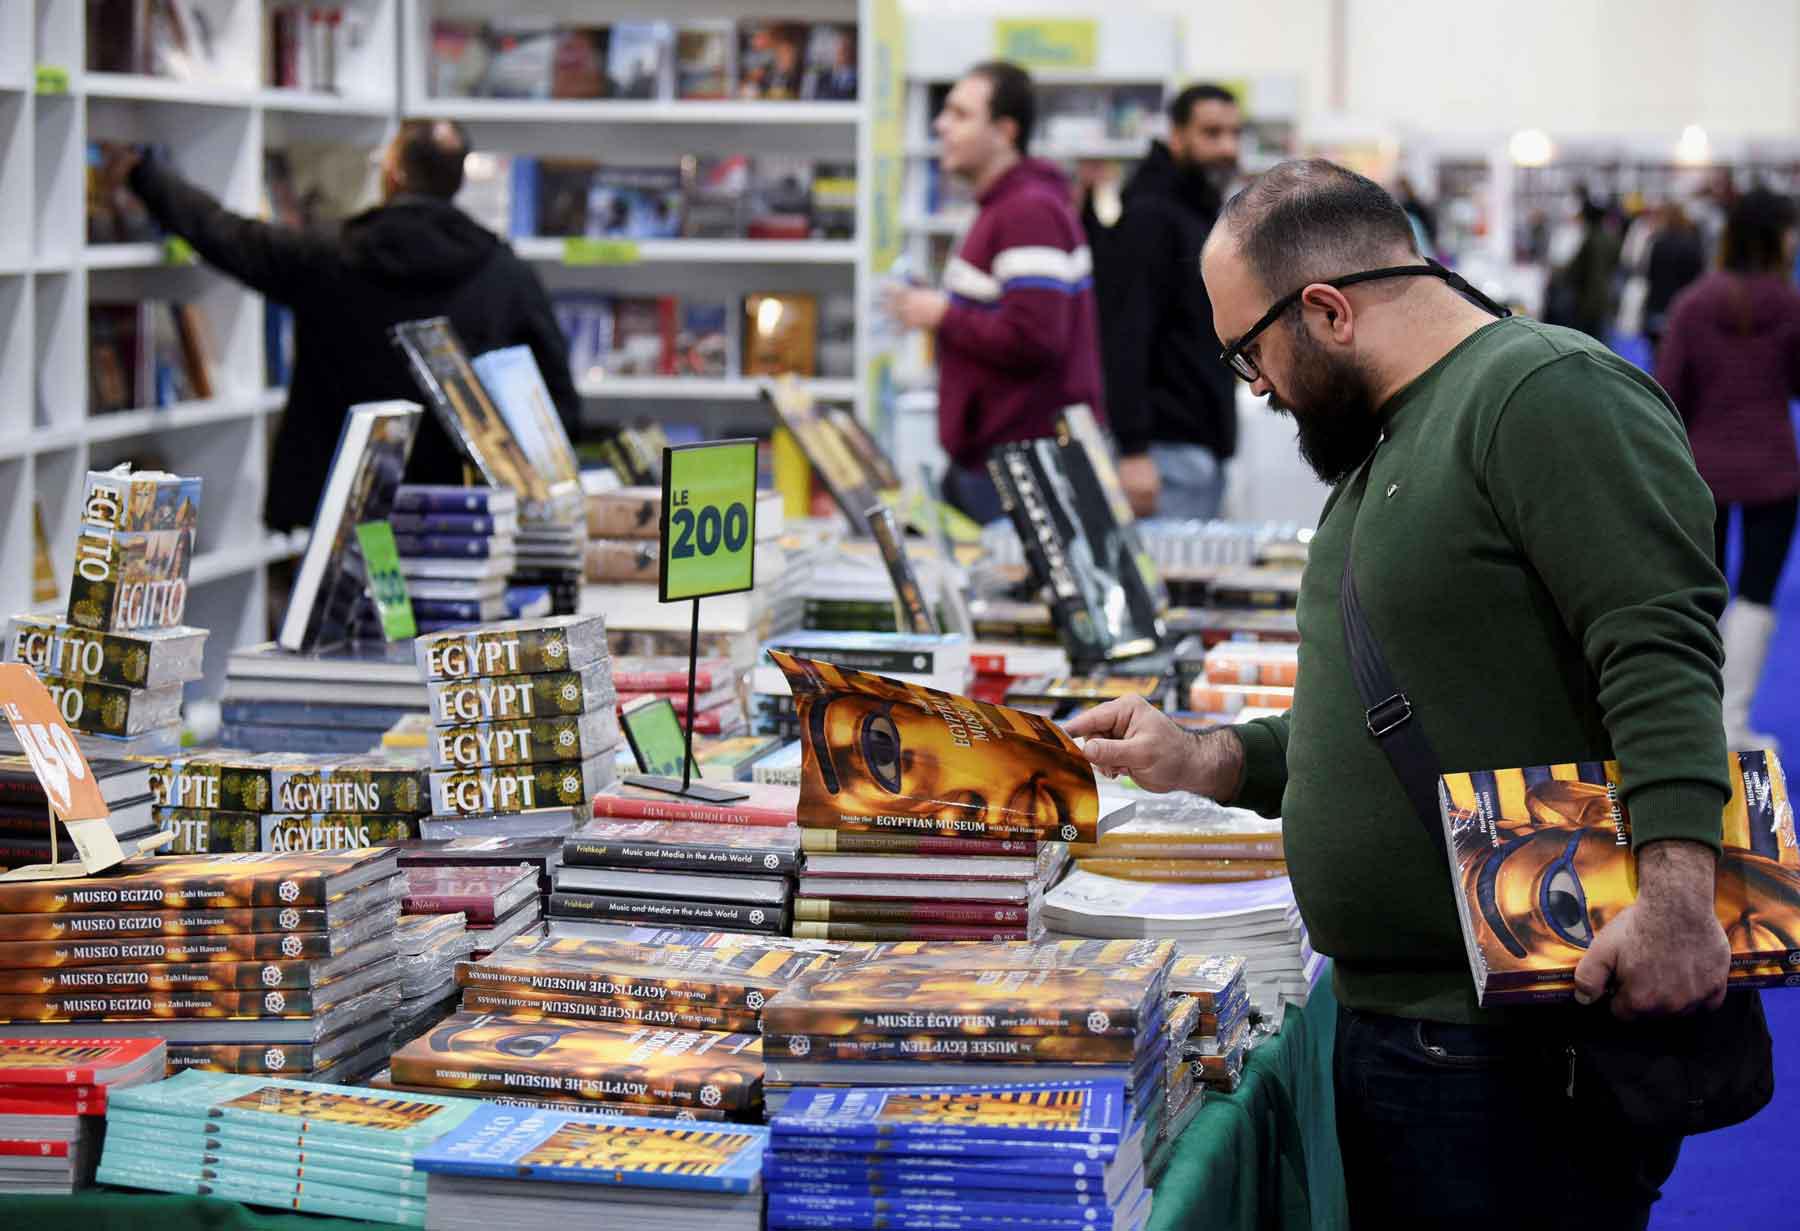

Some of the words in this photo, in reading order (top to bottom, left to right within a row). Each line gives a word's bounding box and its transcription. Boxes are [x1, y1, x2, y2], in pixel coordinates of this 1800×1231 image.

[672, 490, 689, 506] LE
[79, 485, 121, 581] EGITTO
[671, 502, 749, 559] 200
[115, 577, 188, 629] EGITTO
[14, 631, 105, 676] EGITTO
[426, 640, 520, 678] EGYPT
[438, 683, 534, 721] EGYPT
[437, 728, 532, 767] EGYPT
[14, 722, 86, 817] 150
[439, 775, 535, 812] EGYPT
[1606, 781, 1618, 802] the
[877, 815, 933, 829] EGYPTIAN
[936, 819, 985, 832] MUSEUM
[1609, 804, 1628, 846] Inside
[576, 845, 608, 855] Frishkopf
[622, 848, 643, 857] Music
[645, 849, 660, 858] and
[661, 850, 685, 859] Media
[687, 851, 694, 860] in
[695, 851, 707, 860] the
[709, 853, 728, 861] Arab
[730, 854, 753, 863] World
[72, 890, 117, 903] MUSEO
[120, 888, 163, 902] EGIZIO
[180, 890, 196, 898] Zahi
[564, 900, 594, 910] Frishkopf
[609, 903, 630, 912] Music
[632, 904, 647, 913] and
[648, 905, 672, 914] Media
[673, 907, 680, 915] in
[681, 907, 693, 916] the
[695, 908, 713, 917] Arab
[715, 909, 738, 918] World
[71, 918, 116, 931] MUSEO
[119, 917, 162, 930] EGIZIO
[74, 946, 118, 959] MUSEO
[122, 945, 165, 957] EGIZIO
[60, 973, 104, 985] MUSEO
[107, 973, 149, 985] EGIZIO
[468, 971, 499, 981] HAWASS
[532, 976, 587, 991] MUSEUM
[590, 980, 668, 1000] ÄGYPTISCHE
[63, 1000, 107, 1012] MUSEO
[109, 998, 152, 1011] EGIZIO
[477, 995, 508, 1005] HAWASS
[542, 1000, 597, 1016] MUSEUM
[599, 1006, 679, 1024] ÄGYPTISCHE
[877, 1012, 924, 1027] MUSÉE
[927, 1011, 996, 1027] ÉGYPTIEN
[900, 1040, 968, 1056] ÉGYPTIEN
[970, 1040, 1018, 1057] MUSÉE
[504, 1073, 562, 1088] MUSEUM
